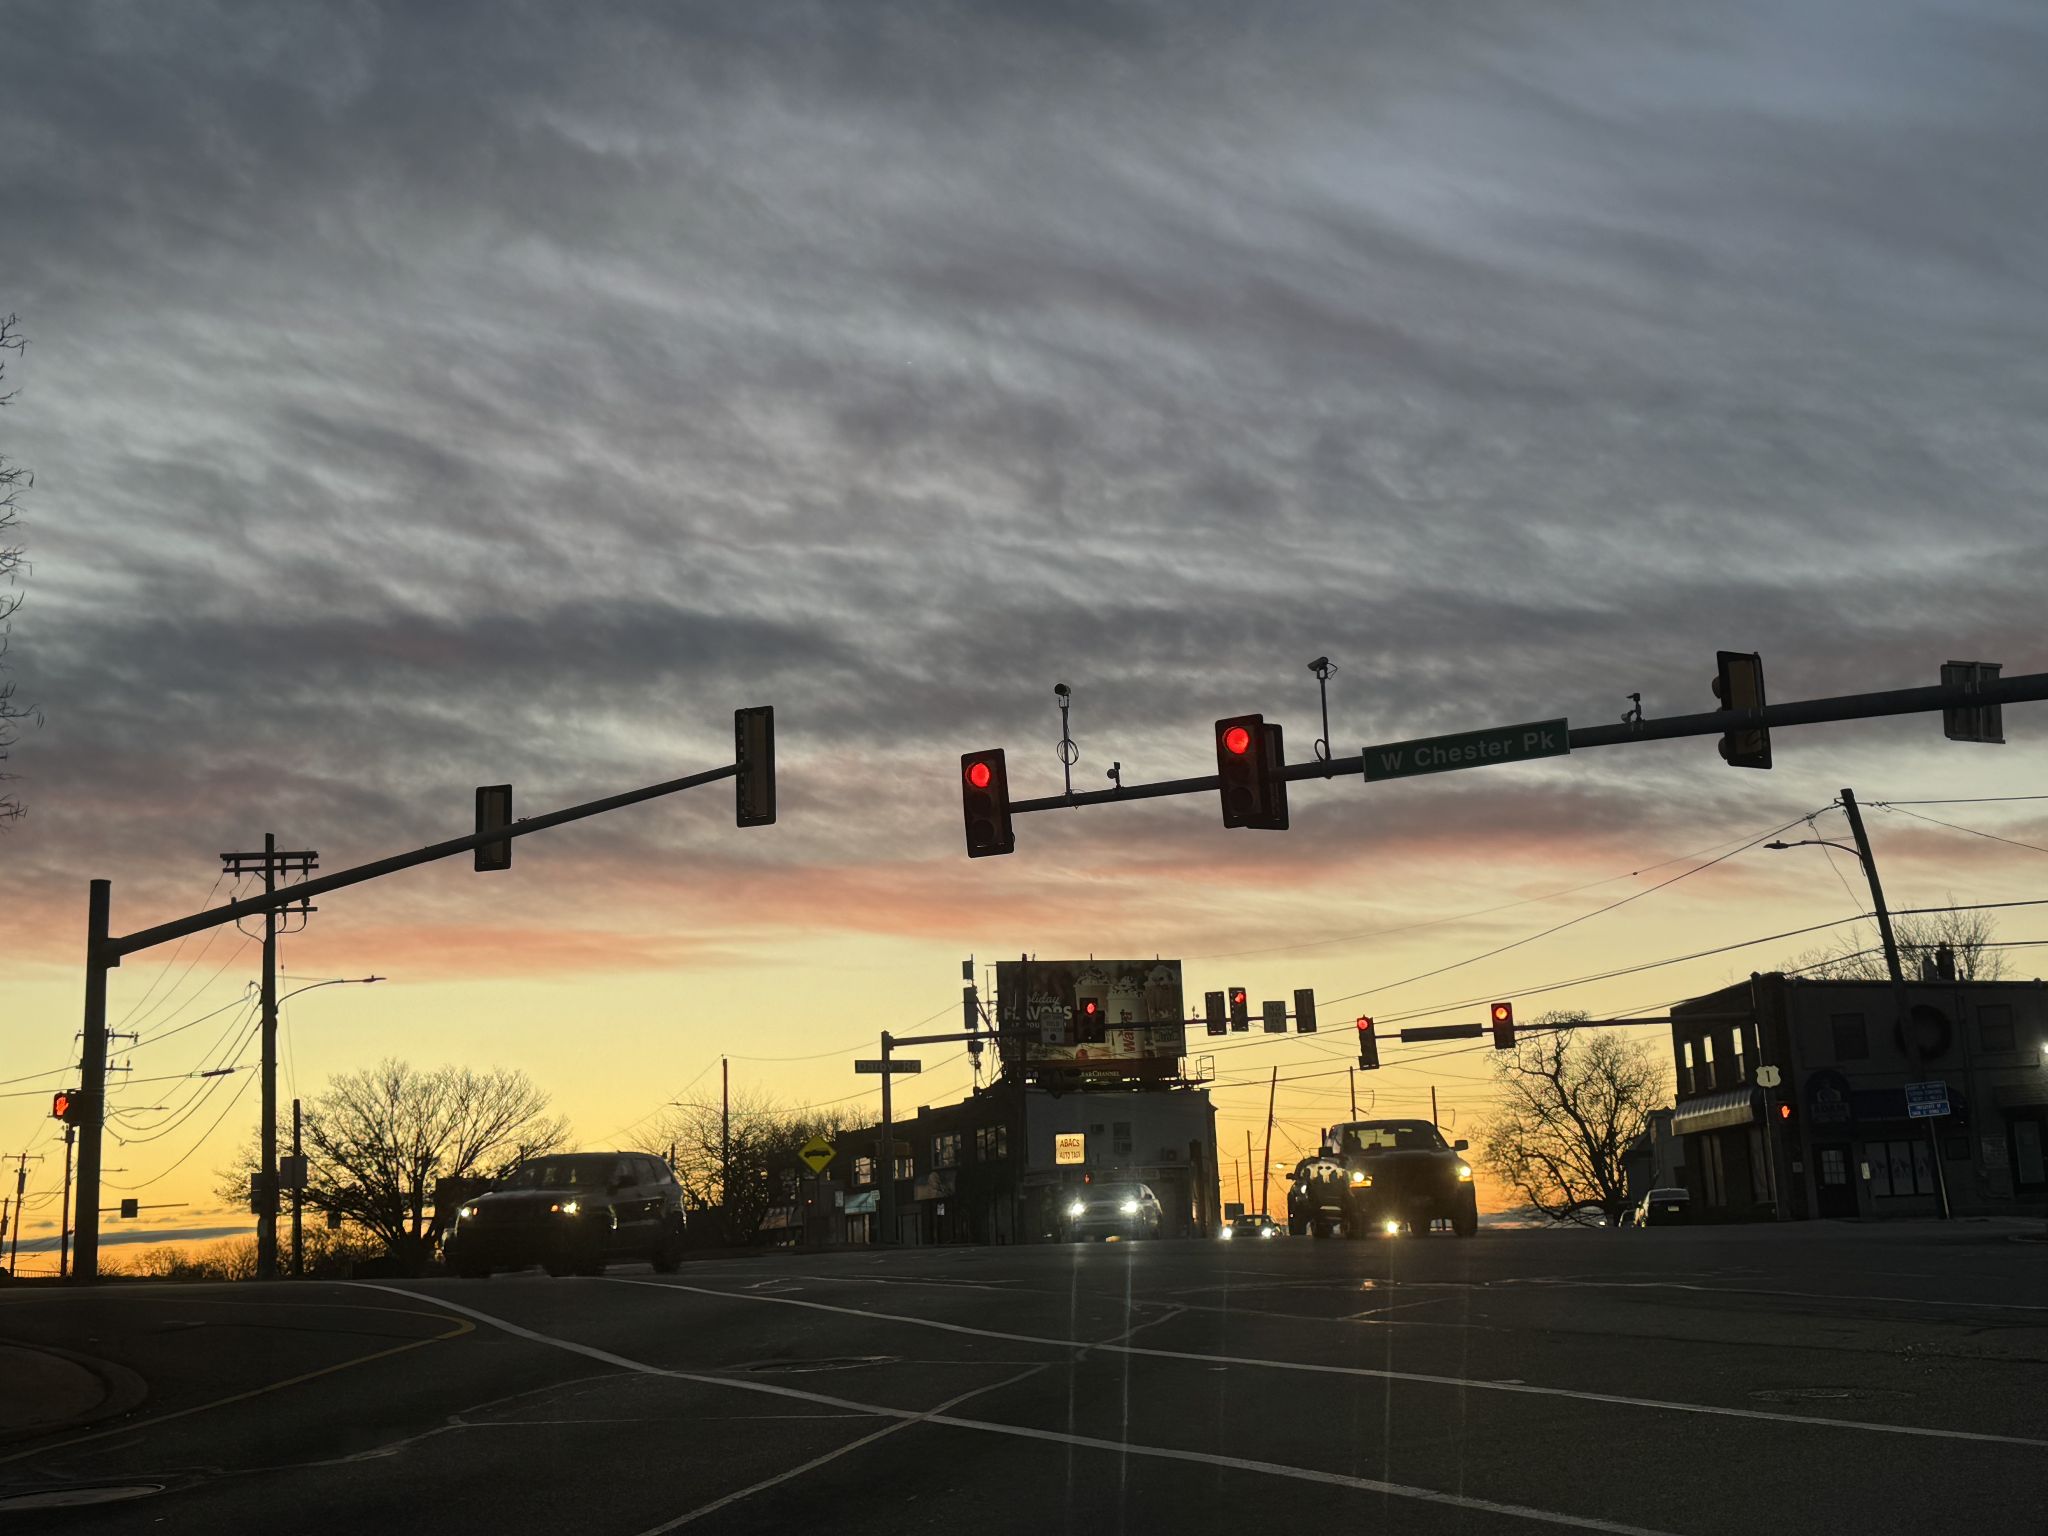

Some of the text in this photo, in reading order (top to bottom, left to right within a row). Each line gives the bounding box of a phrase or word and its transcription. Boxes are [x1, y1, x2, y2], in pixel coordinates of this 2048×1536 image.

[1381, 730, 1555, 771] W Chester Pk
[1766, 1070, 1770, 1082] 1
[1059, 1151, 1070, 1160] AUTO
